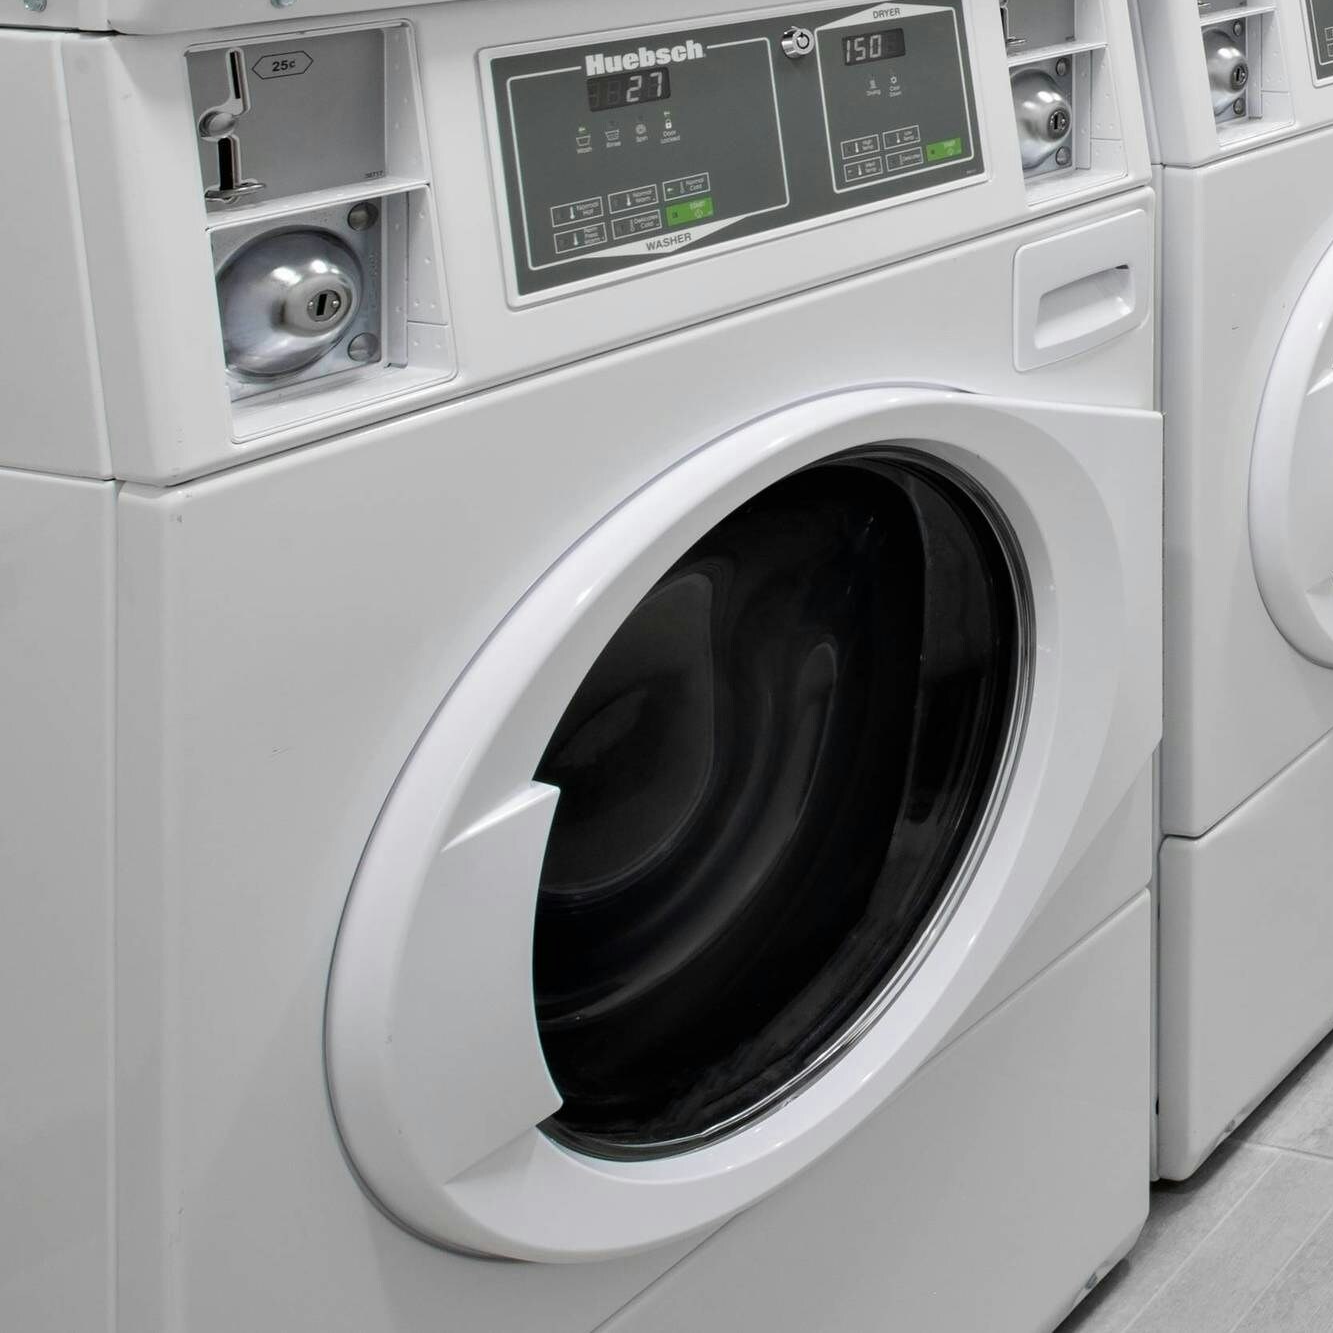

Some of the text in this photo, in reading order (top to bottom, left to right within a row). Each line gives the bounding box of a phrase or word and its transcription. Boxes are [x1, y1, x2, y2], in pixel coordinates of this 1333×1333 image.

[873, 8, 900, 19] DRYER
[585, 40, 704, 76] Huebsch
[847, 35, 881, 63] 150
[626, 72, 662, 102] 27
[646, 232, 692, 251] WASHER
